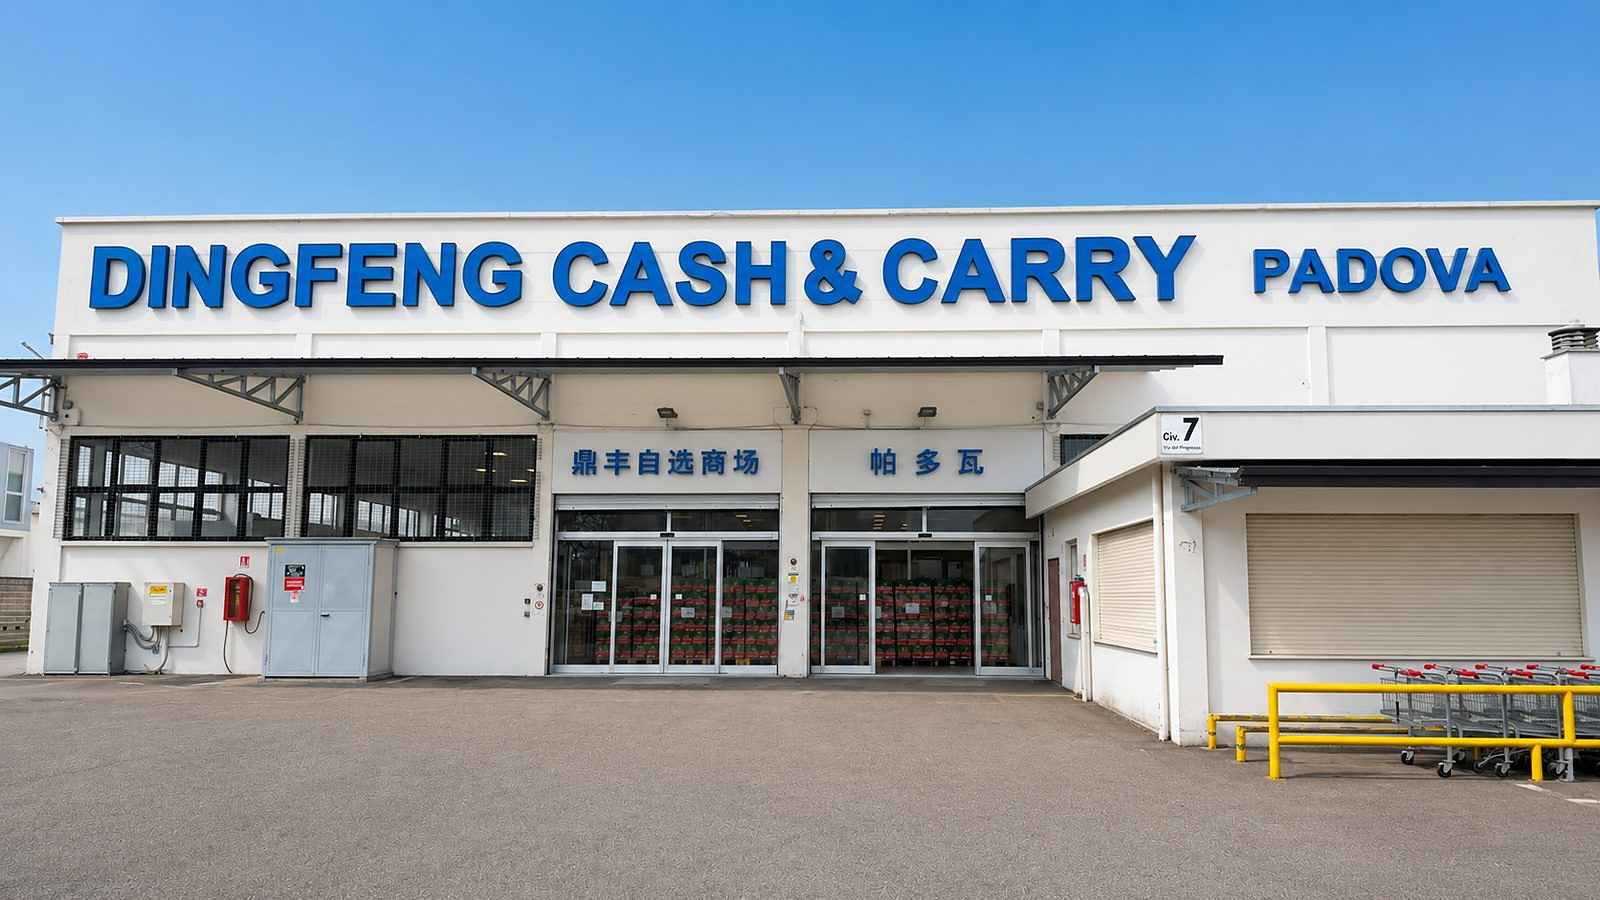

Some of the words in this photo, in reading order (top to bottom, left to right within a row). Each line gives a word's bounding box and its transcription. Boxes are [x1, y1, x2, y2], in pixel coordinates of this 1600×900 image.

[89, 242, 522, 309] DINGFENG
[553, 241, 786, 306] CASH
[804, 240, 862, 304] &
[883, 235, 1195, 304] CARRY
[1253, 248, 1511, 294] PADOVA
[1163, 432, 1180, 442] Civ.
[1183, 417, 1199, 441] 7
[571, 449, 760, 476] 鼎丰自选商场
[870, 448, 984, 475] 帕多瓦
